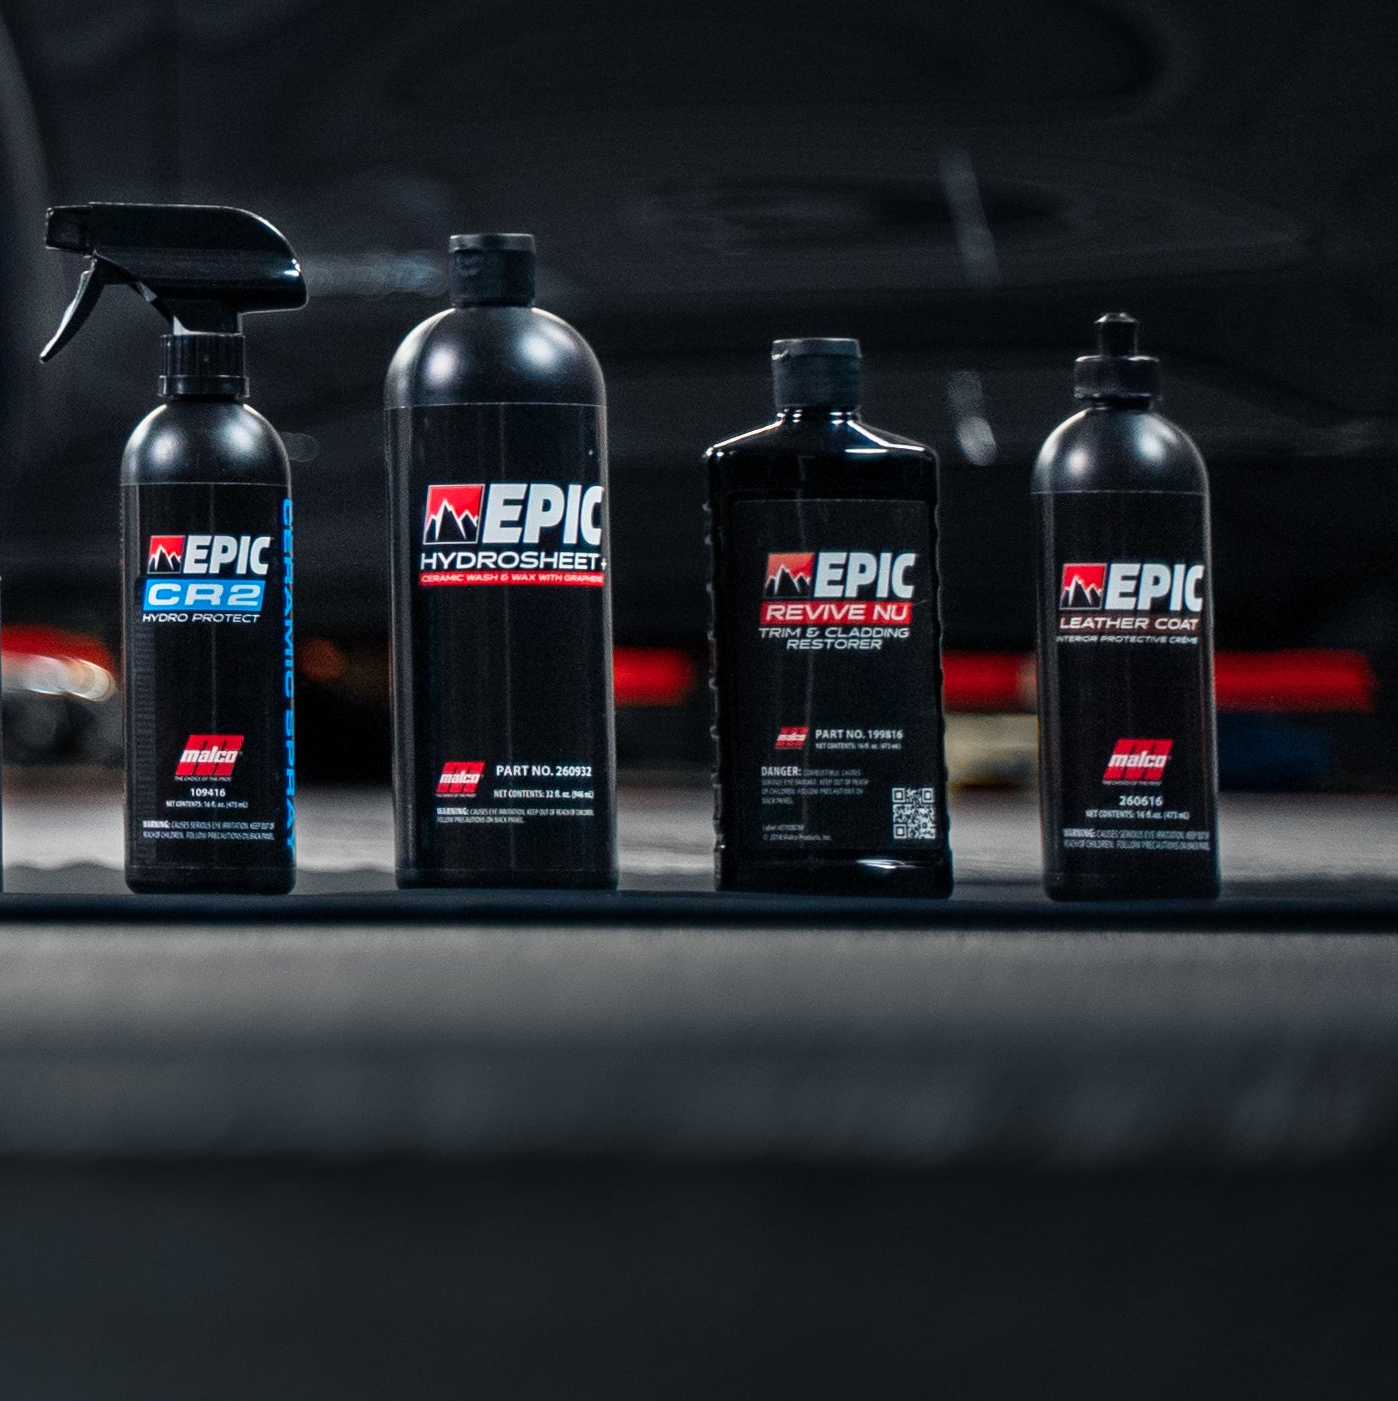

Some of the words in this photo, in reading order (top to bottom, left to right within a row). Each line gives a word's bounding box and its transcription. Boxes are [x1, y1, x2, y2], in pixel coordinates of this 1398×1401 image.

[483, 484, 604, 545] EPIC
[183, 536, 271, 574] EPIC
[421, 573, 463, 582] CERAMIC
[467, 573, 498, 582] WASH
[512, 573, 535, 582] WAX
[539, 573, 562, 582] WITH
[814, 552, 916, 598] EPIC
[1105, 563, 1204, 612] EPIC
[149, 584, 260, 606] CR2
[766, 605, 865, 620] REVIVE
[873, 605, 908, 620] NU
[143, 614, 188, 623] HYDRO
[192, 614, 260, 623] PROTECT
[1060, 617, 1150, 629] LEATHER
[1155, 618, 1199, 630] COAT
[759, 628, 801, 638] TRIM
[806, 628, 820, 638] &
[825, 628, 909, 638] CLADDING
[787, 639, 882, 649] RESTORER
[1100, 635, 1167, 643] PROTECTIVE
[816, 729, 843, 739] PART
[846, 729, 865, 739] NO.
[868, 729, 903, 739] 199816
[180, 746, 238, 763] malco
[1108, 751, 1167, 767] malco
[496, 765, 528, 776] PART
[532, 765, 553, 776] NO.
[556, 765, 592, 776] 260932
[761, 766, 802, 776] DANGER:
[440, 771, 480, 783] malco
[191, 788, 225, 797] 109416
[494, 790, 507, 798] NET
[546, 790, 553, 798] 32
[1119, 796, 1163, 806] 260616
